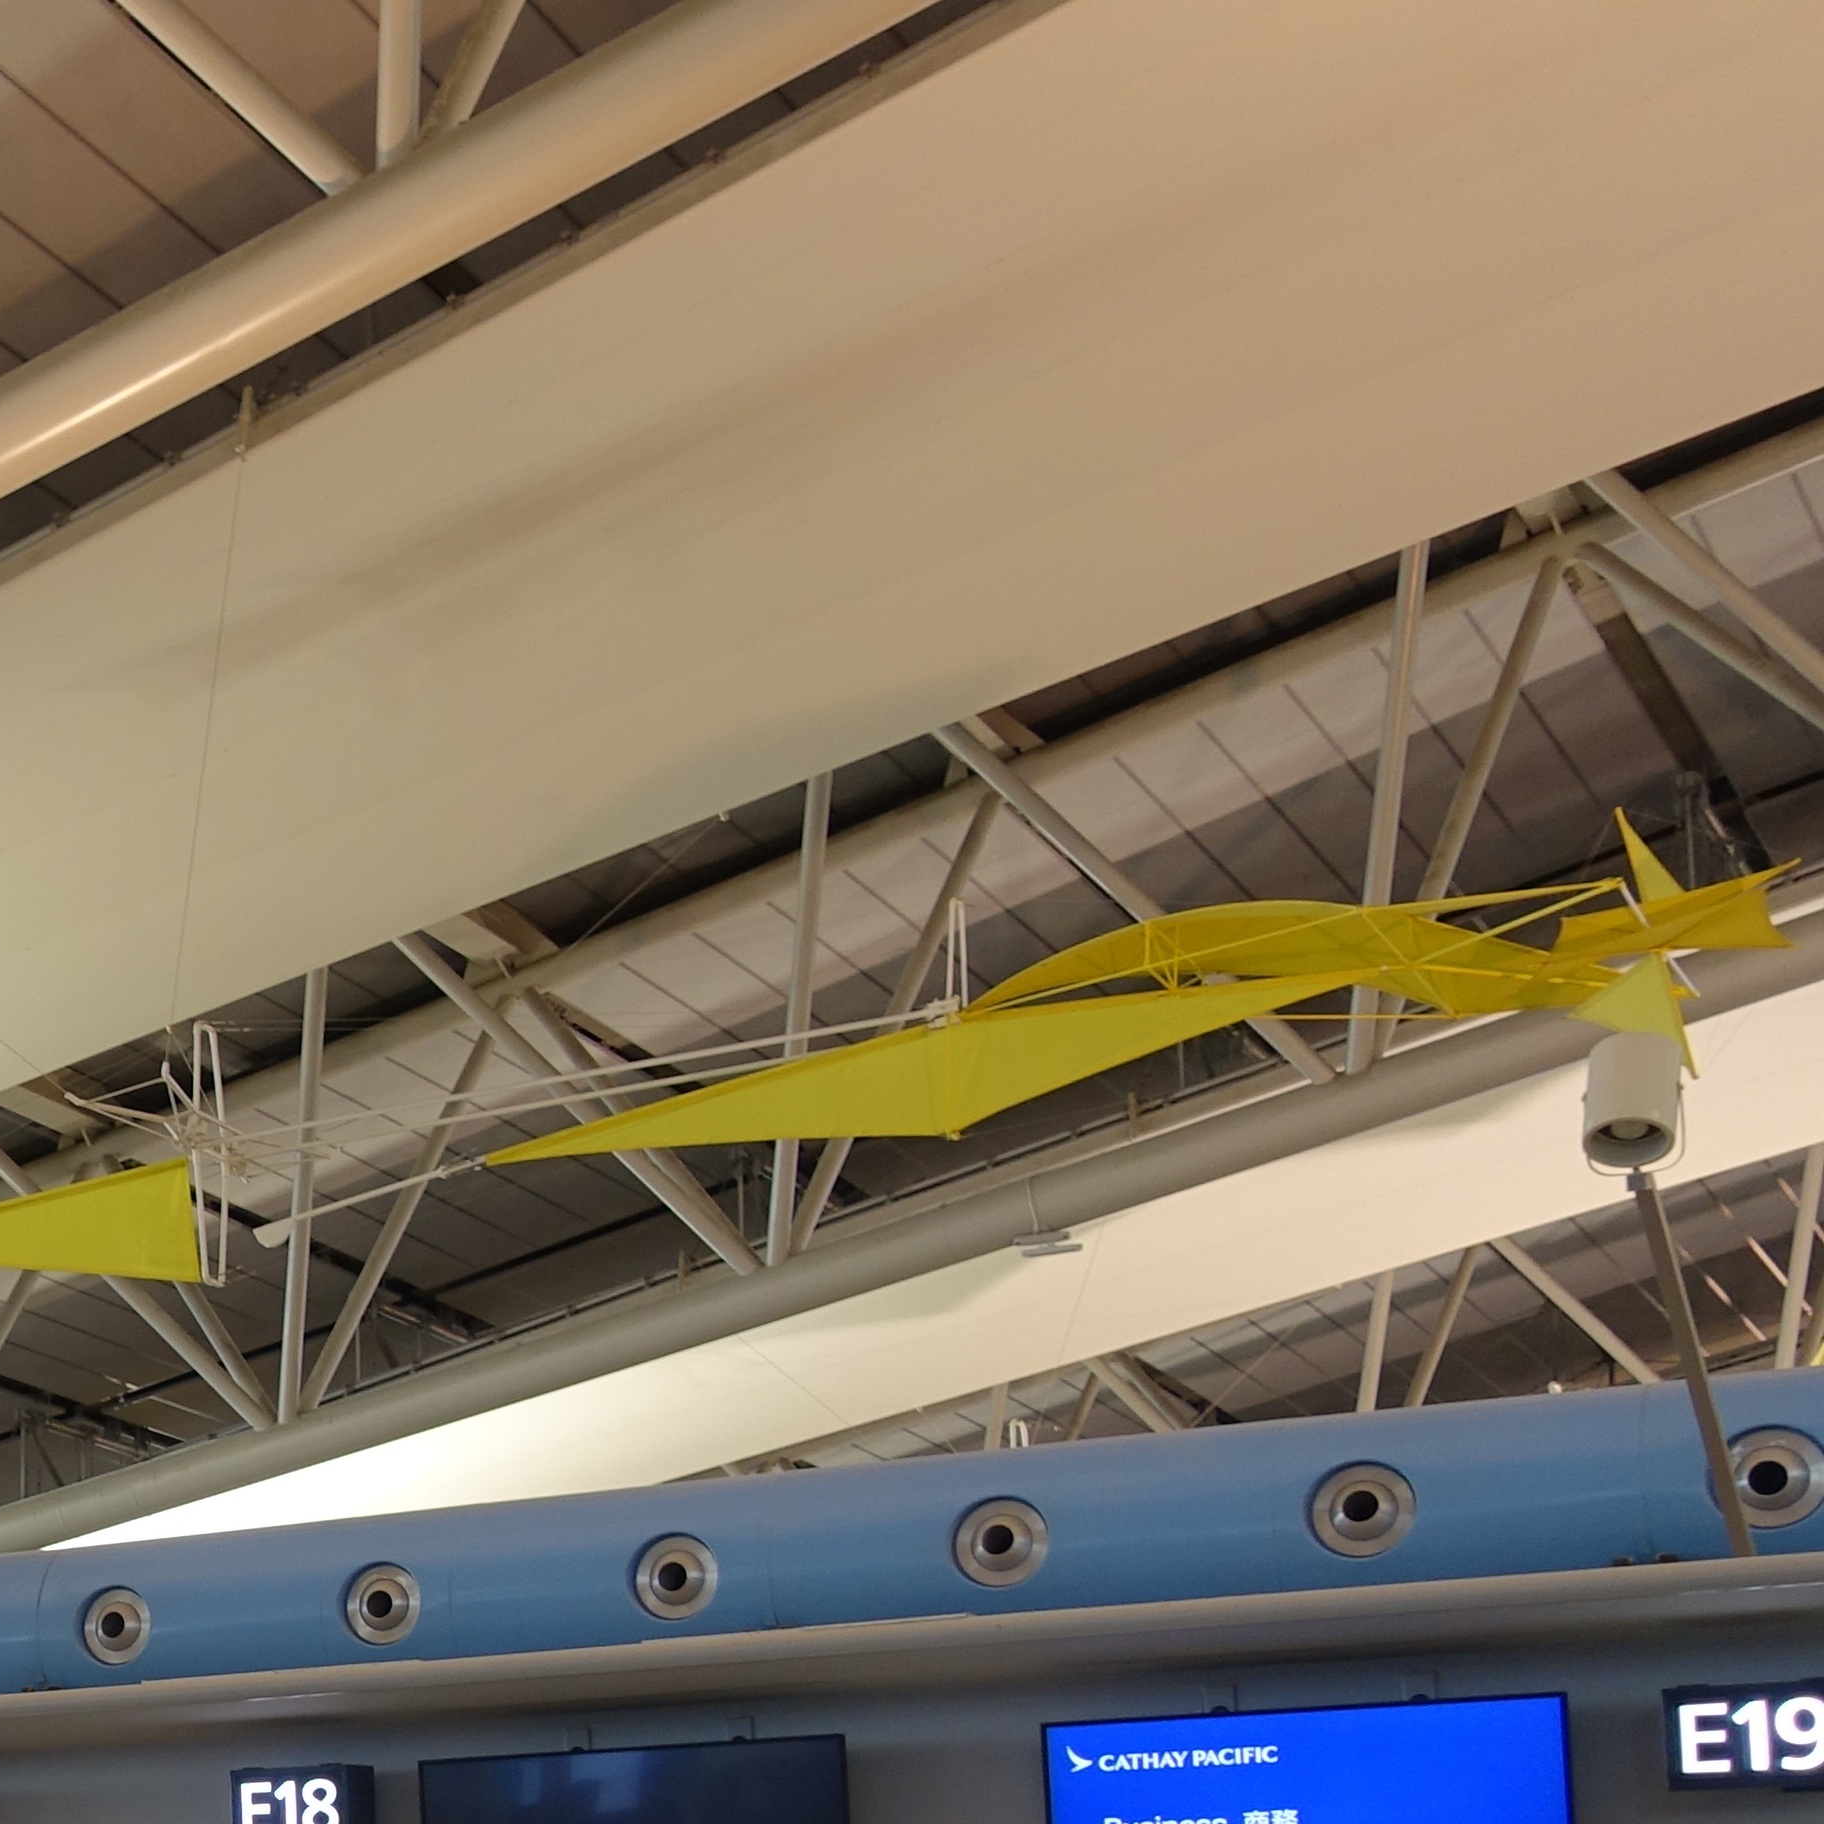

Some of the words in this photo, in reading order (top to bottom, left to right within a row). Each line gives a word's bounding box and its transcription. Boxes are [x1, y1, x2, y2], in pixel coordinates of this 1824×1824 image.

[1098, 1750, 1188, 1771] CATHAY
[1192, 1745, 1279, 1767] PACIFIC
[1678, 1696, 1824, 1774] E19
